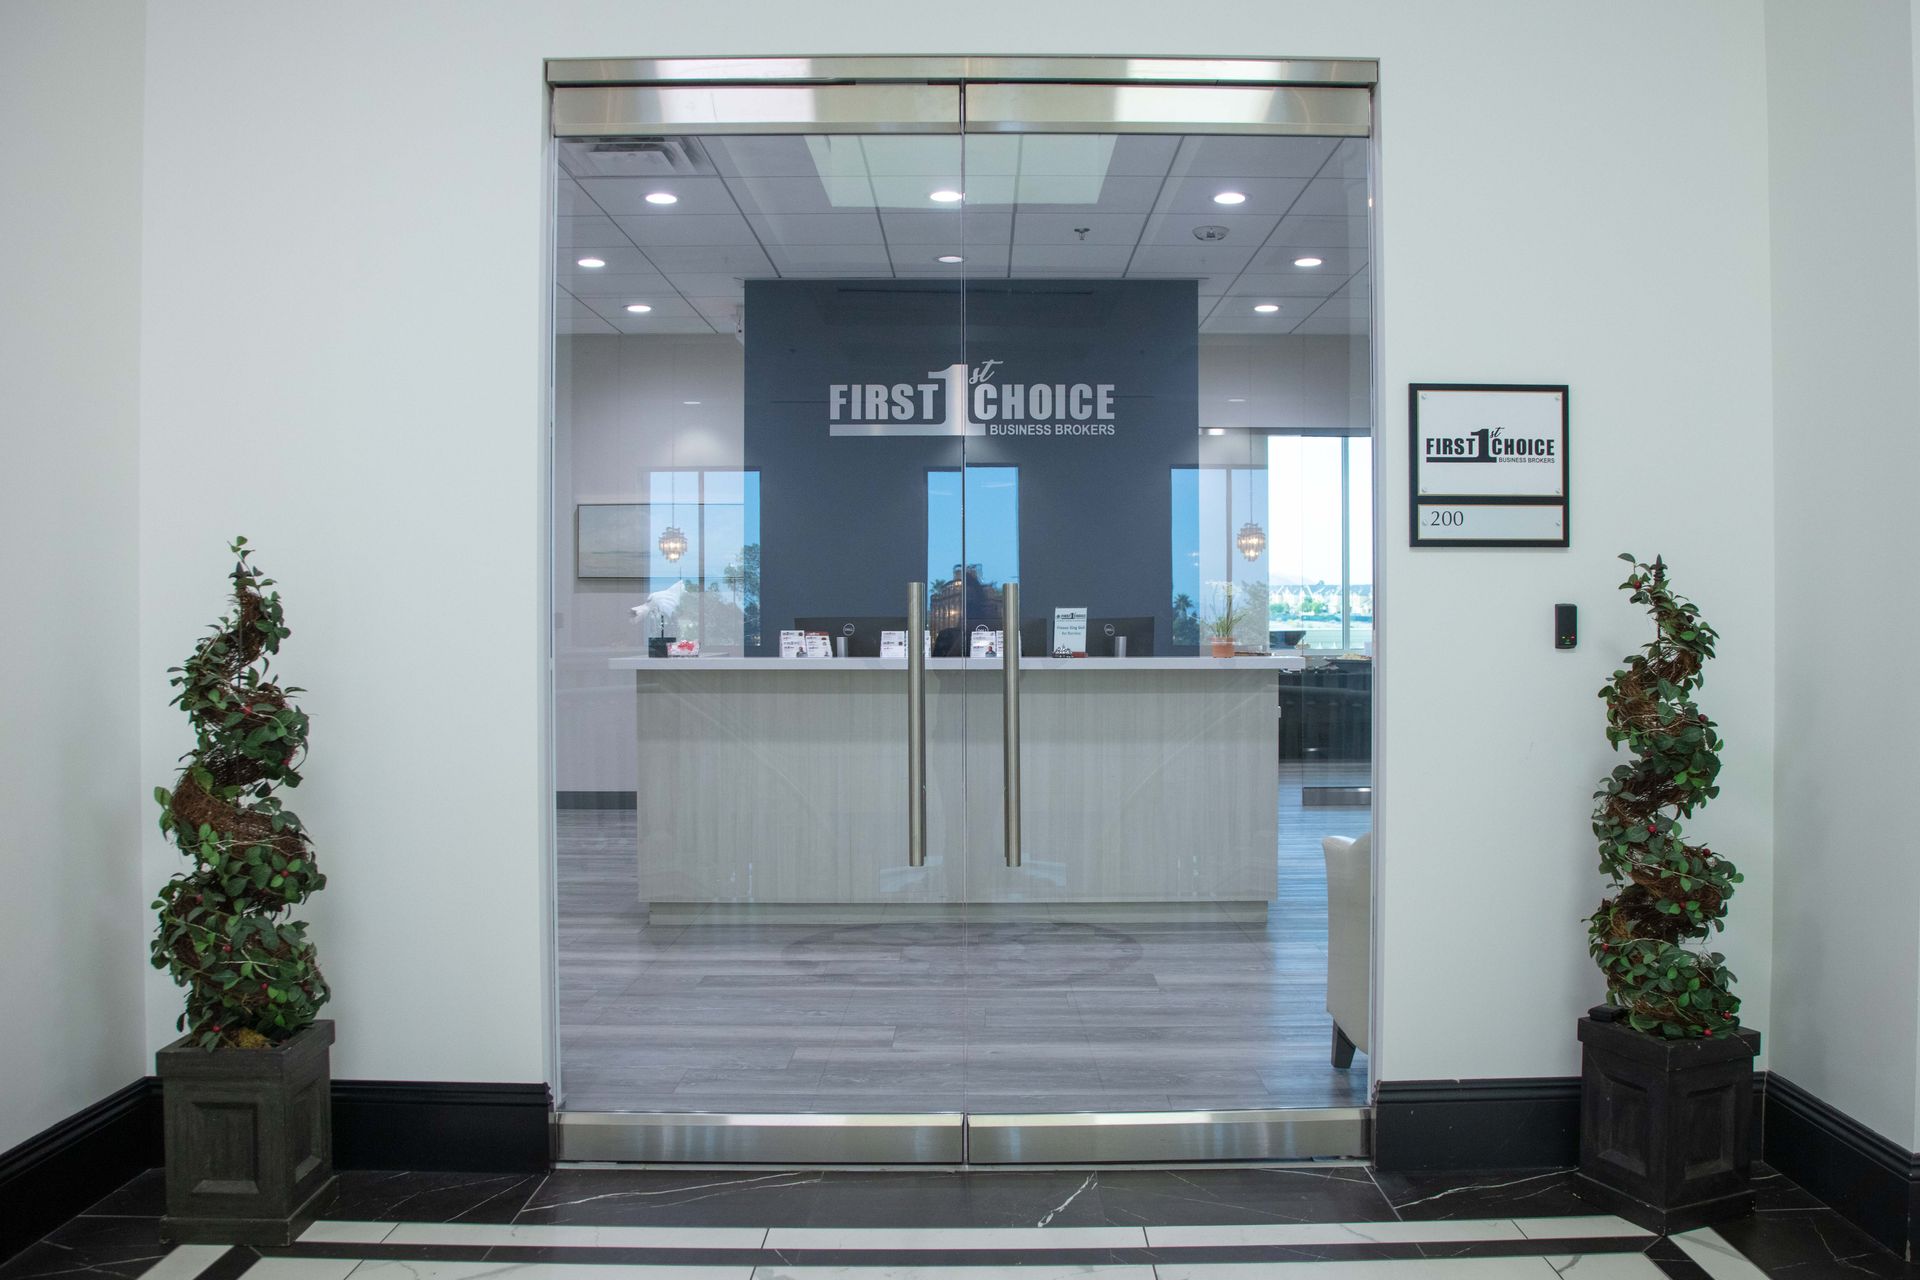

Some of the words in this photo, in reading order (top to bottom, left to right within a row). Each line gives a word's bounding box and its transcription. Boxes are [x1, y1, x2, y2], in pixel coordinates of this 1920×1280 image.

[829, 384, 938, 420] FIRST
[974, 383, 1115, 420] CHOICE
[989, 424, 1051, 436] BUSINESS
[1055, 424, 1115, 436] BROKERS
[1426, 438, 1475, 455] FIRST
[1492, 438, 1555, 456] CHOICE
[1430, 511, 1464, 526] 200
